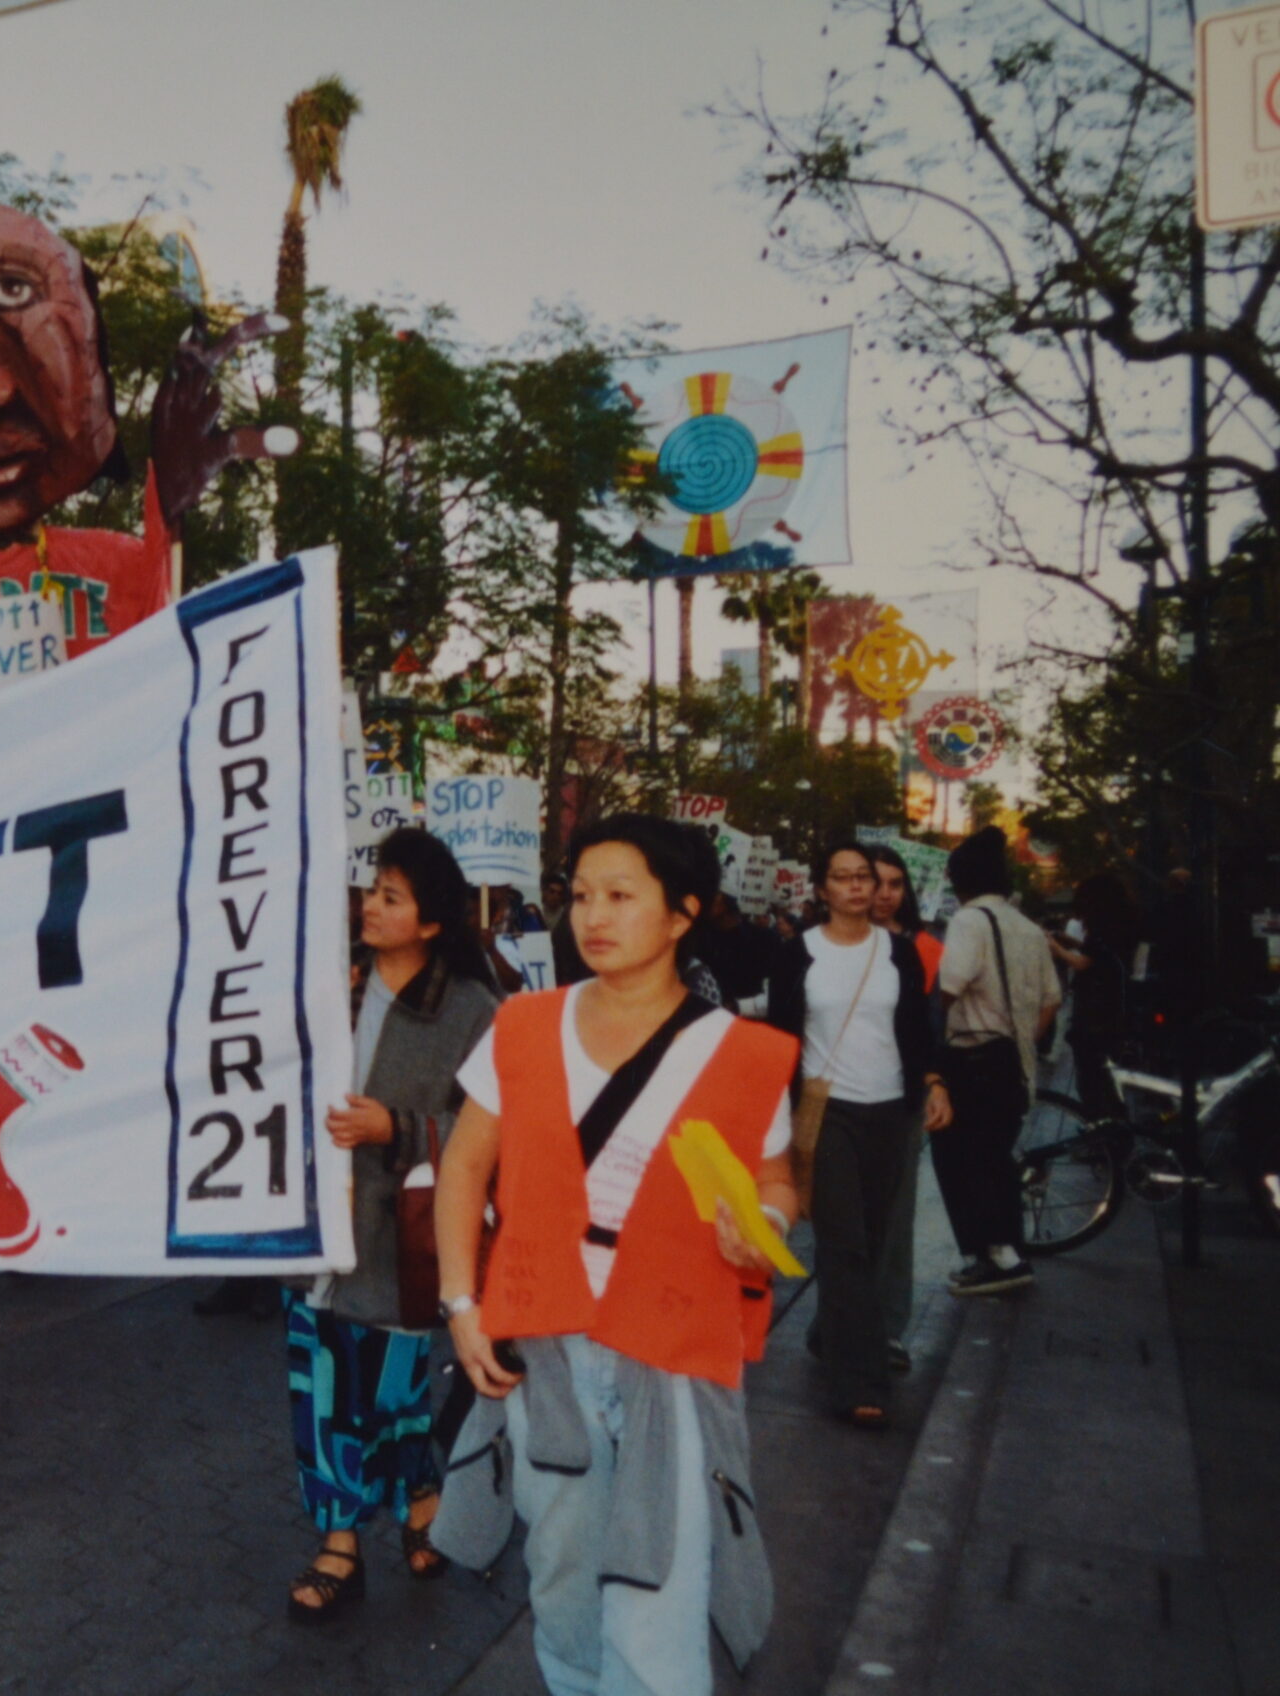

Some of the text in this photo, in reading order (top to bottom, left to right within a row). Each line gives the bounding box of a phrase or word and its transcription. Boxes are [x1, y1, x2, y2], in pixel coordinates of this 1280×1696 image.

[432, 778, 504, 816] STOP
[209, 625, 269, 1095] FOREVER
[187, 1104, 287, 1202] 21
